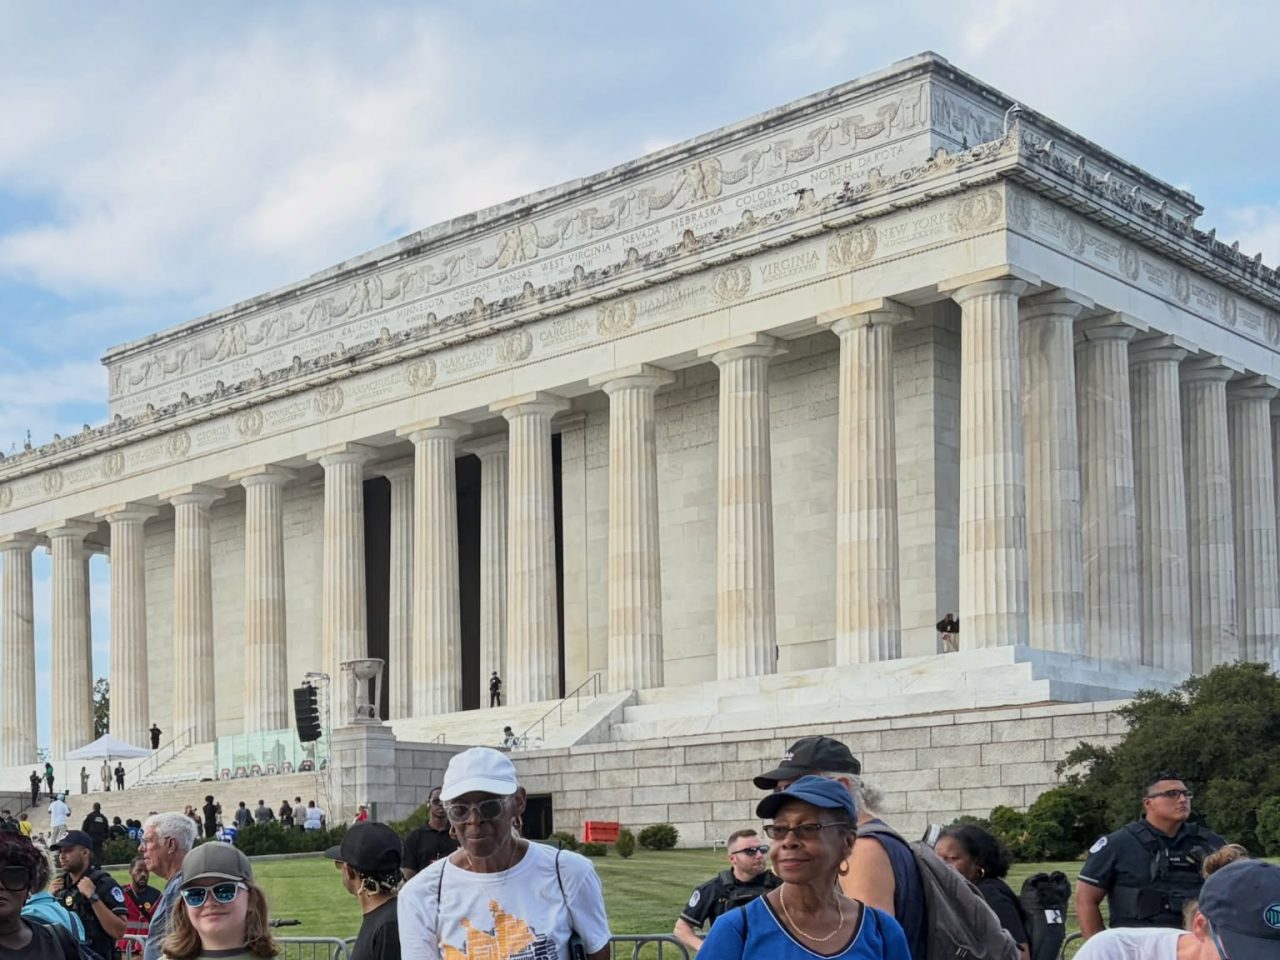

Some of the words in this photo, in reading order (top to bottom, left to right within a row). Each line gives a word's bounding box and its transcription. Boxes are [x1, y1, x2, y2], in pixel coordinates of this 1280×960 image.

[811, 161, 852, 184] NORTH
[858, 144, 904, 167] DAKOTA
[735, 179, 800, 208] COLORADO
[671, 205, 724, 230] NEBRASKA
[879, 222, 908, 241] NEW
[912, 212, 947, 231] YORK
[622, 226, 660, 246] NEVADA
[540, 257, 565, 272] WEST
[568, 243, 611, 263] VIRGINIA
[759, 250, 820, 275] VIRGINIA
[498, 269, 532, 286] KANSAS
[452, 282, 490, 301] OREGON
[396, 297, 445, 318] MINNESOTA
[440, 347, 494, 370] MARYLAND
